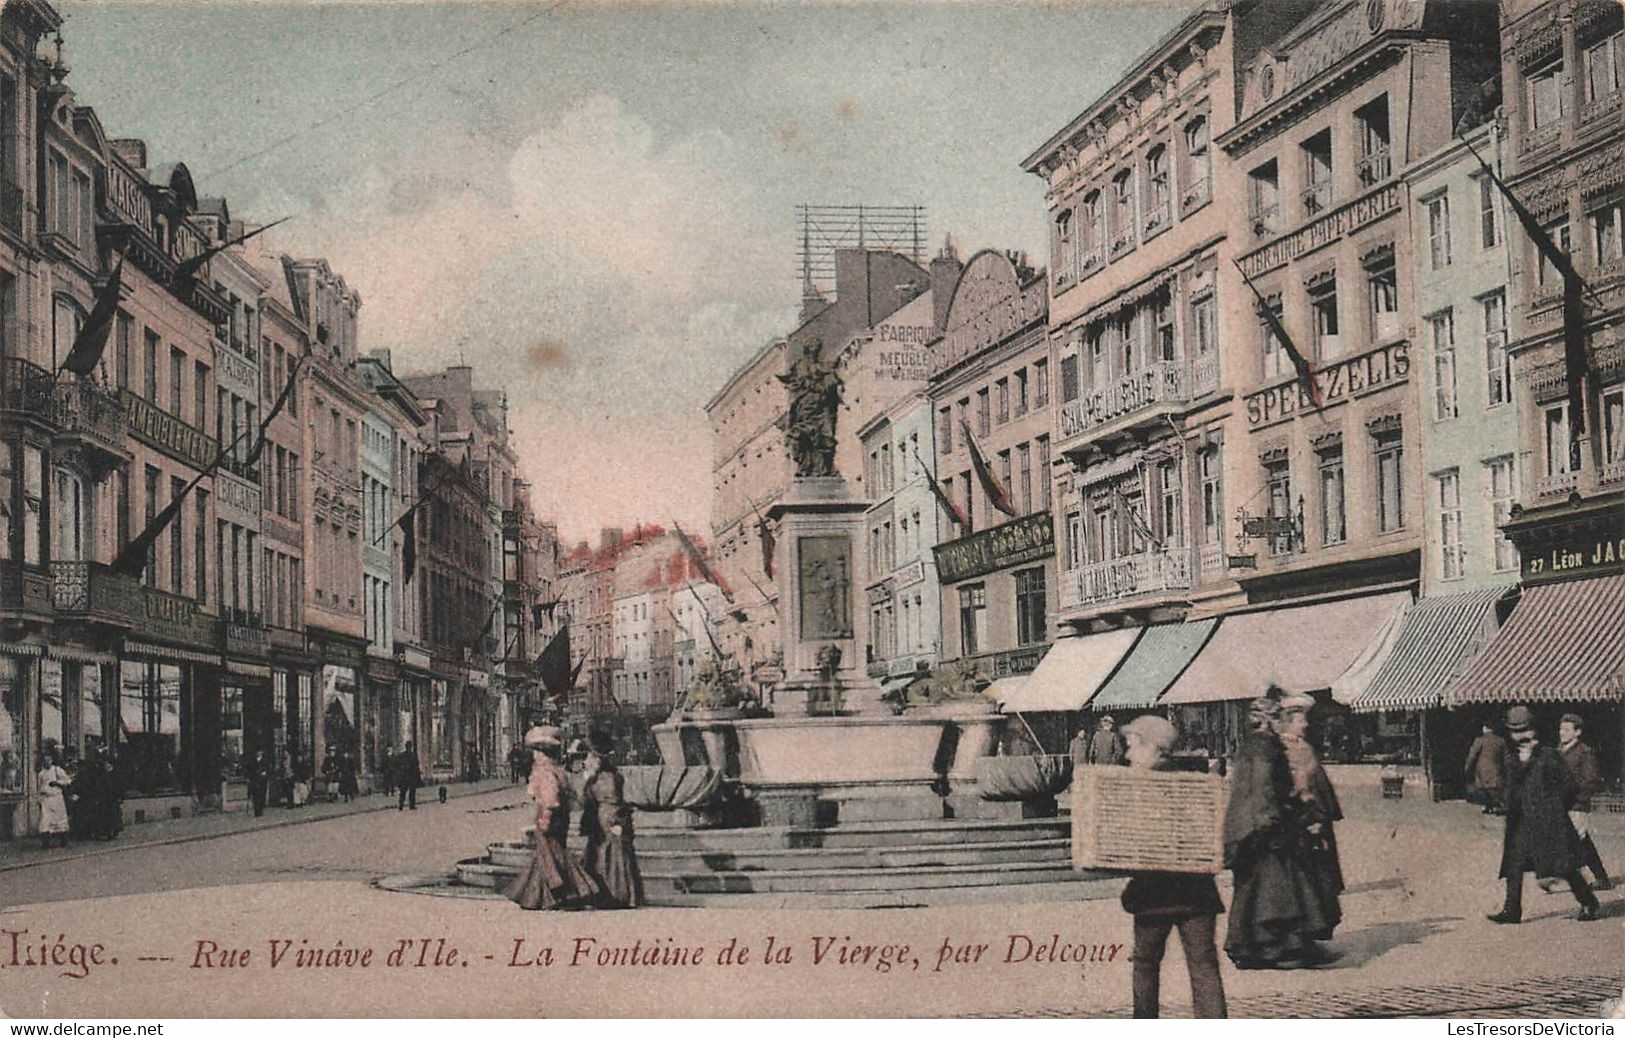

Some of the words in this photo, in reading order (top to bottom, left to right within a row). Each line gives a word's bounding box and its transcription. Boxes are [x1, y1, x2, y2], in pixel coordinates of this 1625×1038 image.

[1243, 229, 1305, 275] LIBRAIRIE
[1310, 183, 1400, 248] PAPETERIE
[880, 324, 935, 344] FABRIQU
[128, 398, 214, 468] AMEUBLEMENT
[1530, 558, 1544, 574] 27
